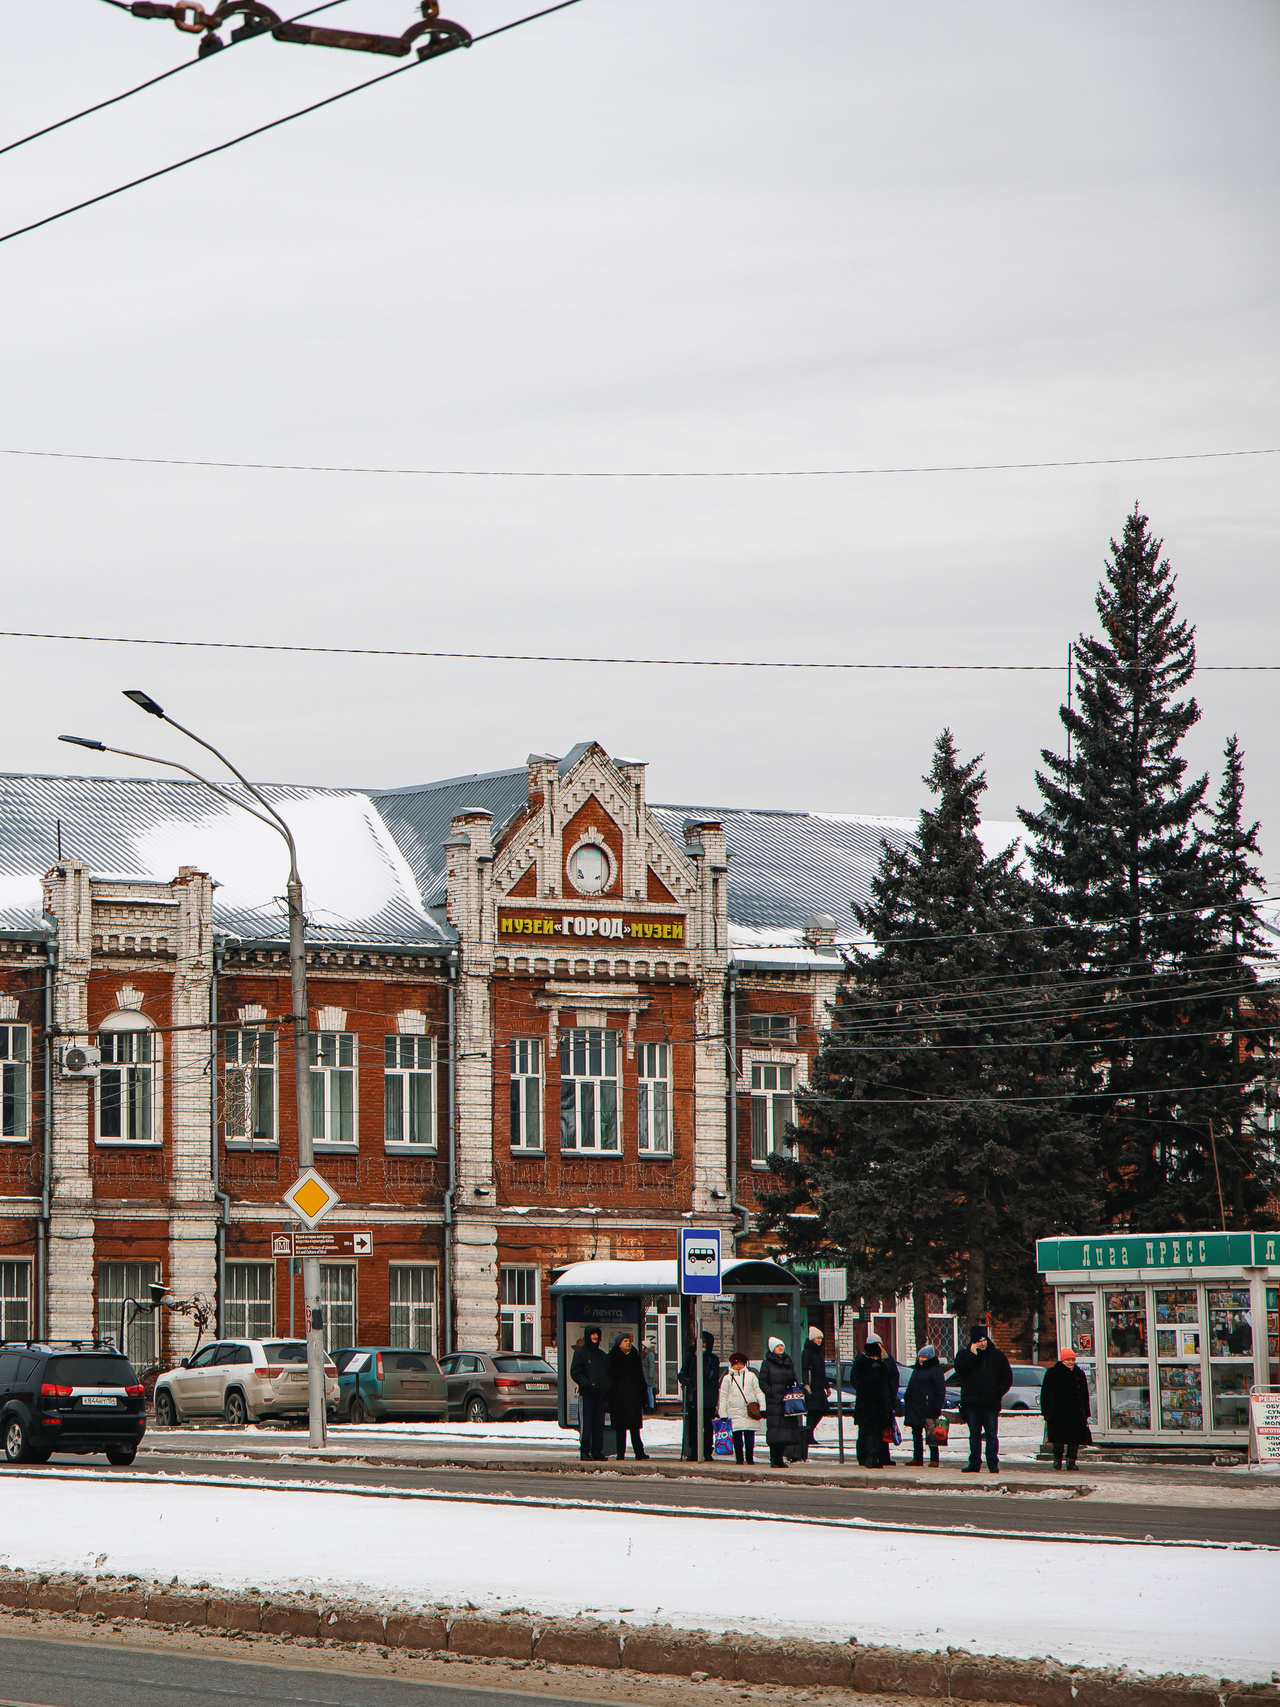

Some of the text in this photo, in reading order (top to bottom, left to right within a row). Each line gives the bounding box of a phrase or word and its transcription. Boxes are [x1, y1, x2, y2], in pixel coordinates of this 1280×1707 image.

[501, 916, 683, 939] МУЗЕЙ «ГОРОД» МУЗЕЙ
[1082, 1240, 1206, 1267] Лига ПРЕСС
[592, 1309, 623, 1317] лента
